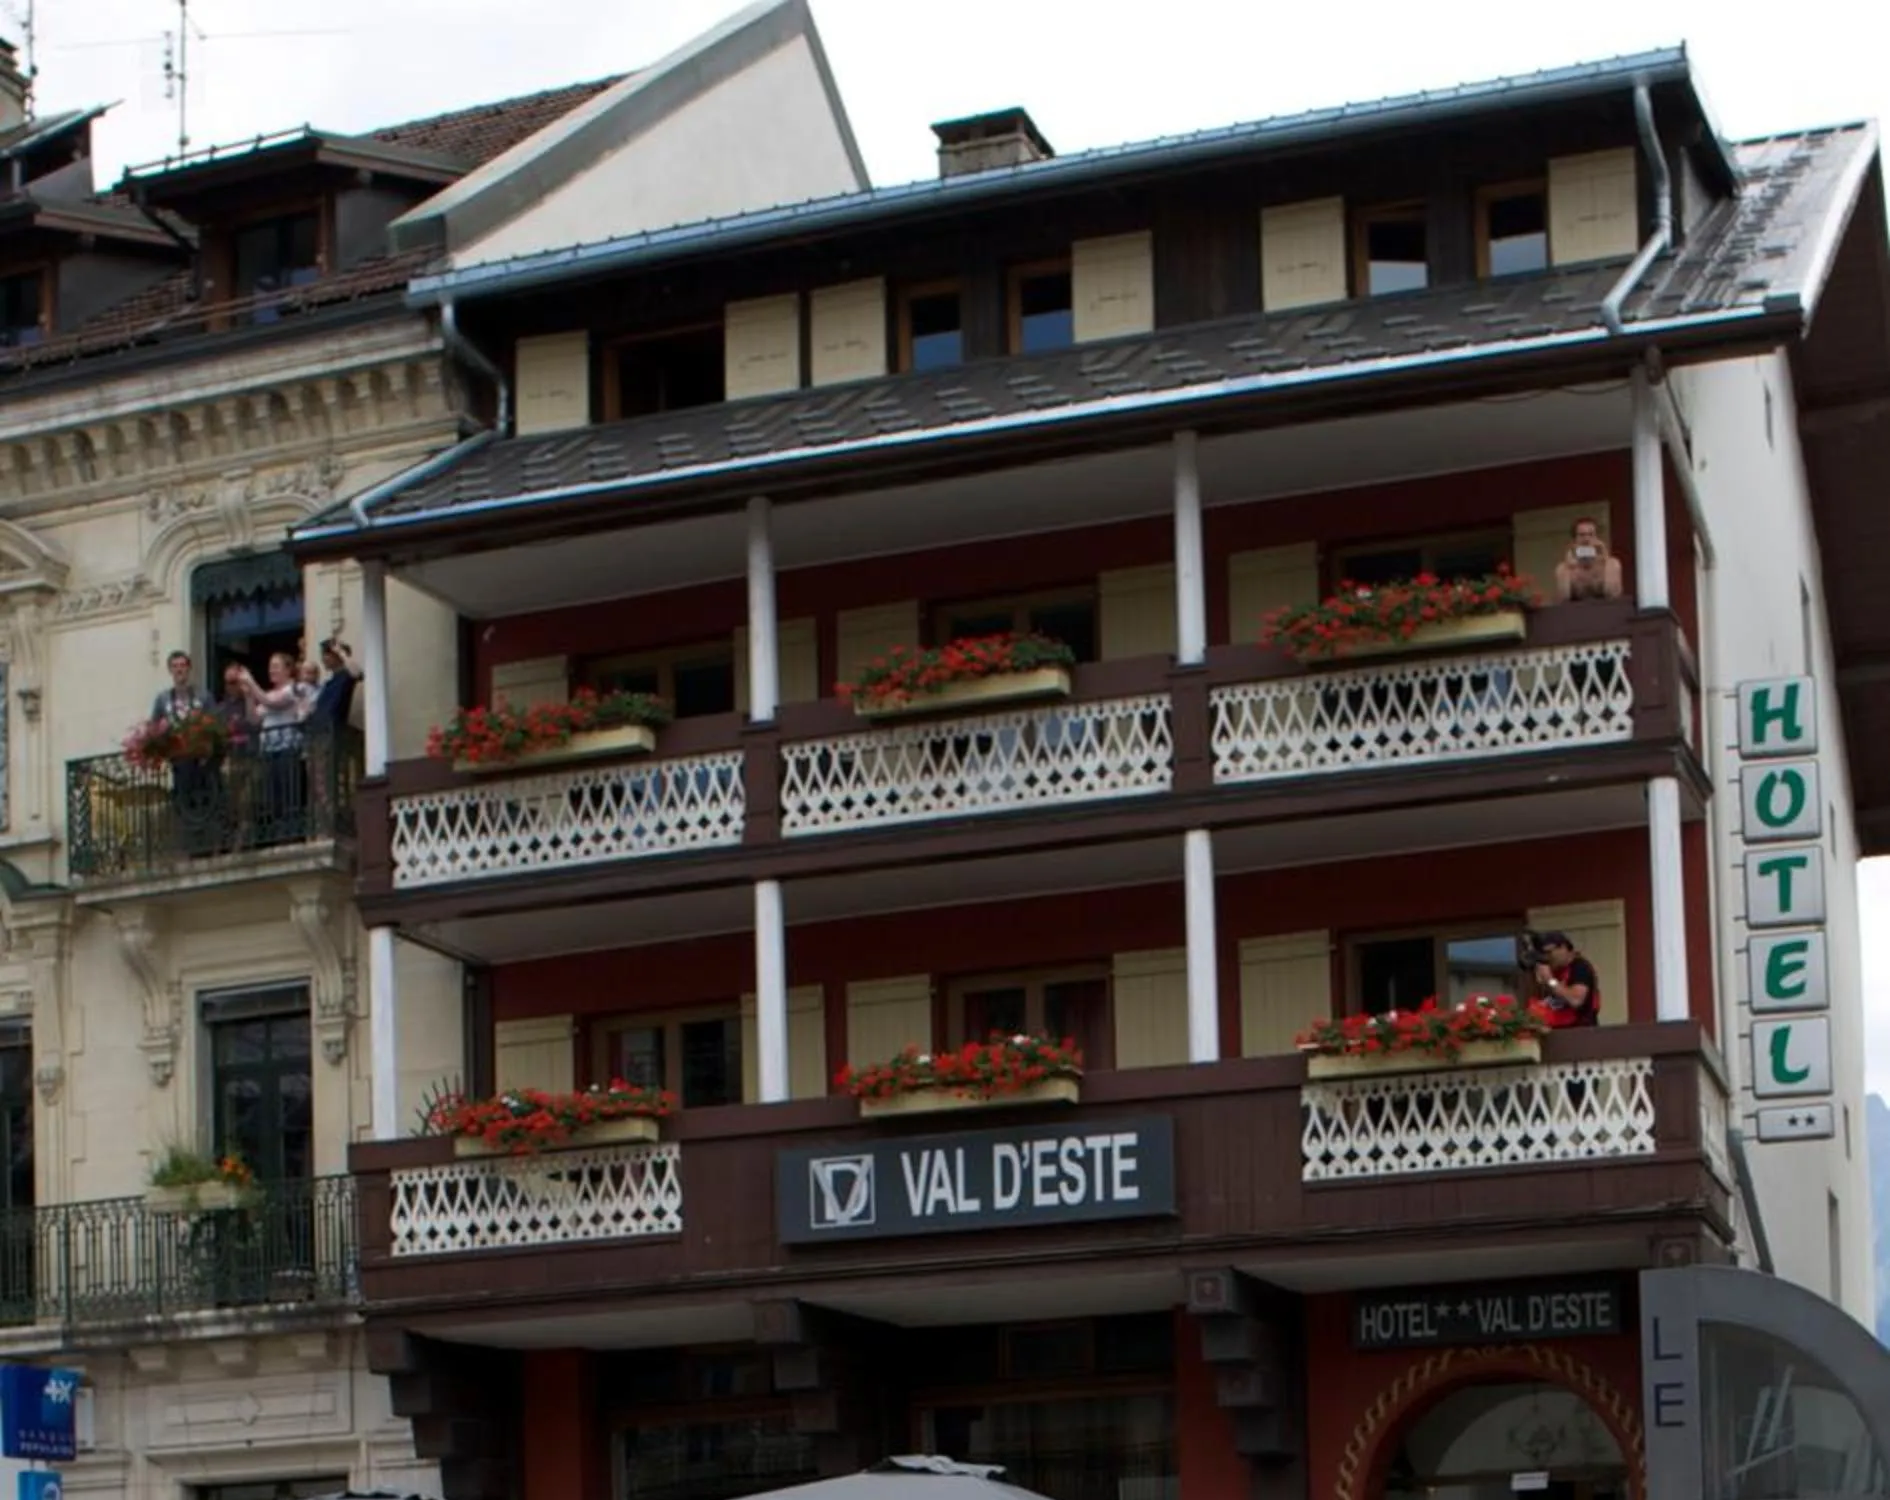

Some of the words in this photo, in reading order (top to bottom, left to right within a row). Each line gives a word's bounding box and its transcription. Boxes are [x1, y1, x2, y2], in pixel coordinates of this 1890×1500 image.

[1750, 683, 1810, 1084] HOTEL
[902, 1148, 980, 1217] VAL
[993, 1133, 1139, 1210] D'ESTE
[1360, 1302, 1438, 1341] HOTEL
[1476, 1296, 1522, 1334] VAL
[1528, 1291, 1612, 1332] D'ESTE
[1652, 1316, 1685, 1427] LE
